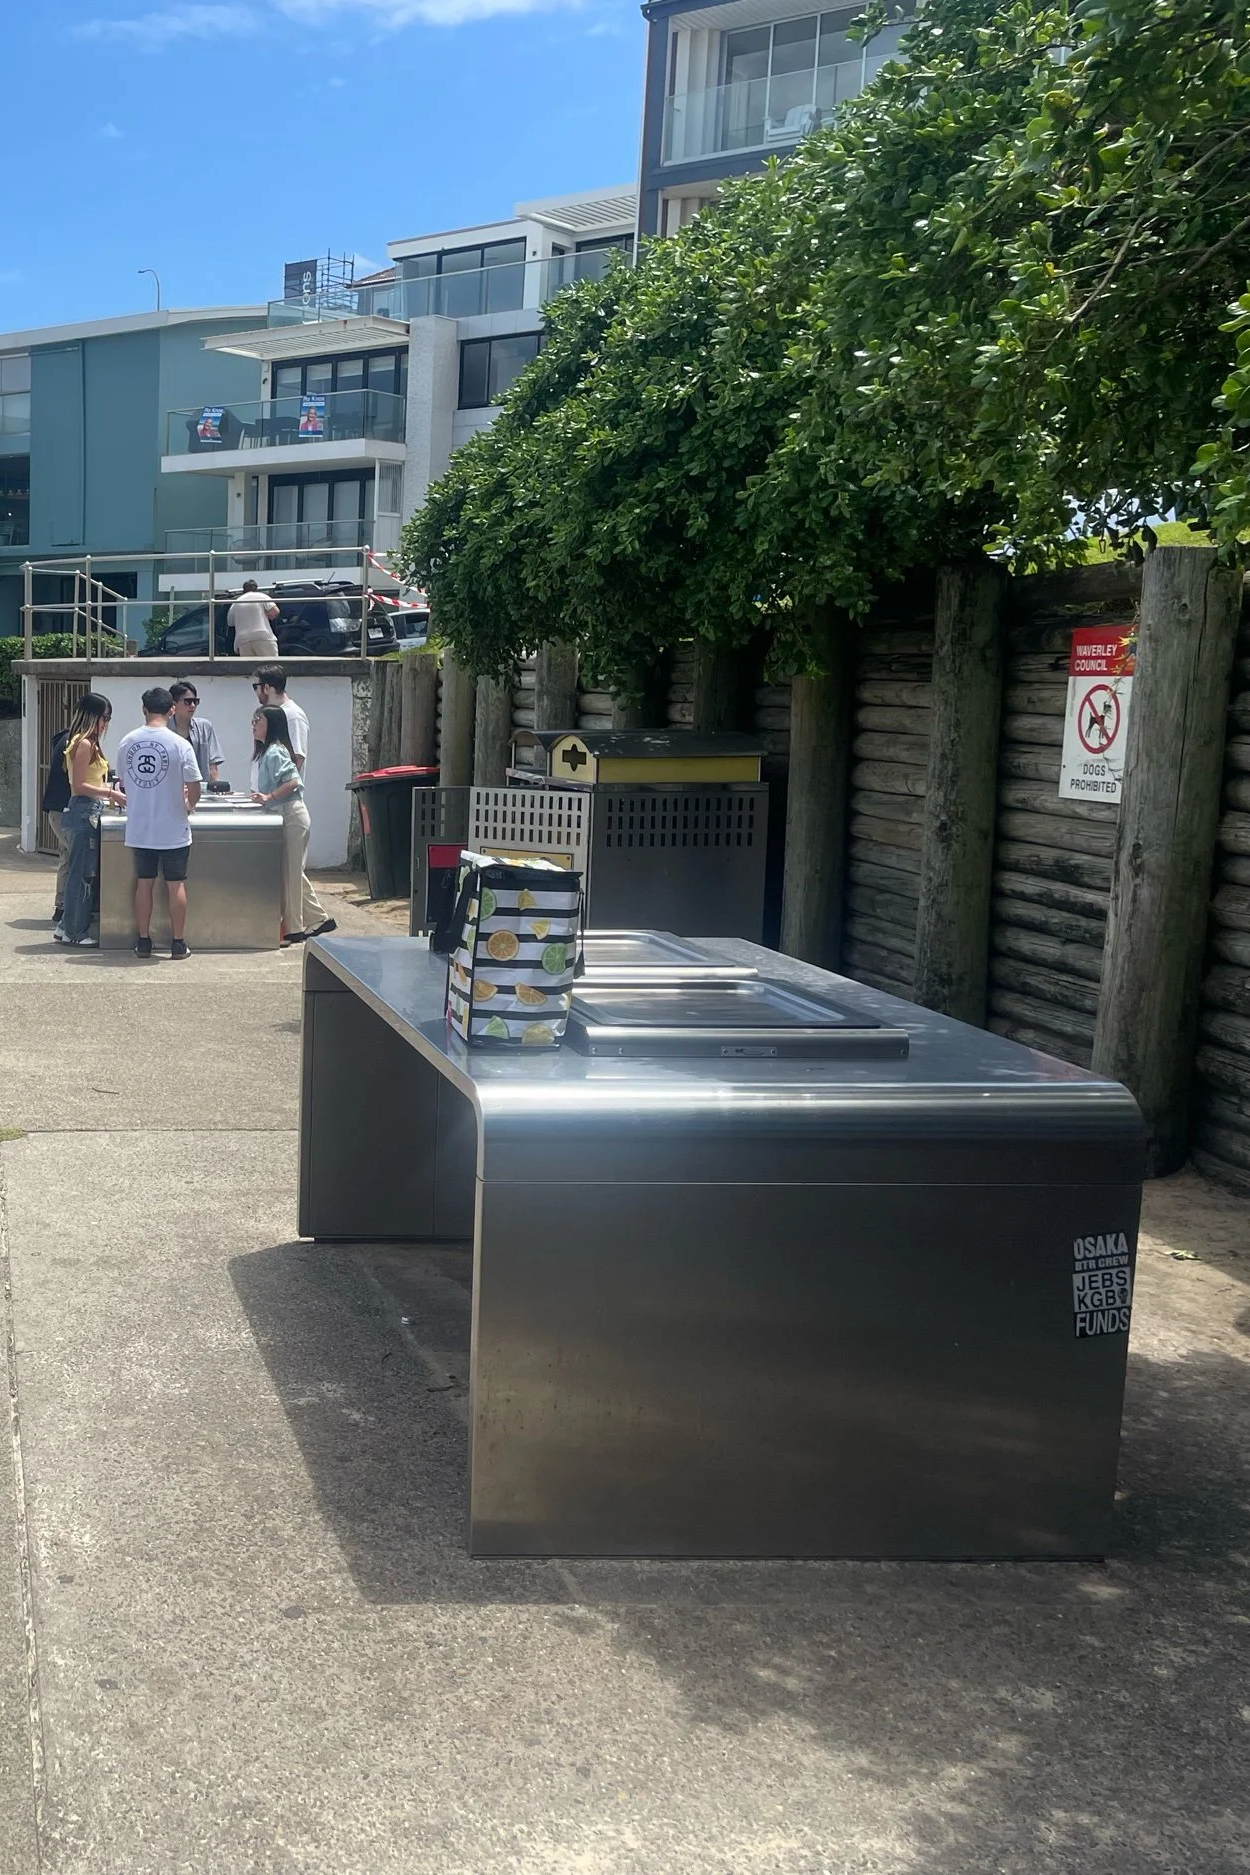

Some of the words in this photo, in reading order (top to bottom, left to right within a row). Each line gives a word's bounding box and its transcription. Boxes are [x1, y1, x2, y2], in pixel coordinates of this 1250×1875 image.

[1076, 644, 1118, 656] WAVERLEY
[1074, 659, 1108, 671] COUNCIL
[126, 743, 141, 770] LONDON
[1083, 763, 1106, 776] DOGS
[1070, 778, 1117, 793] PROHIBITED
[1073, 1232, 1128, 1260] OSAKA
[1098, 1254, 1129, 1268] CREW
[1076, 1269, 1128, 1292] JEBS
[1077, 1288, 1116, 1311] KGB
[1075, 1307, 1130, 1337] FUNDS
